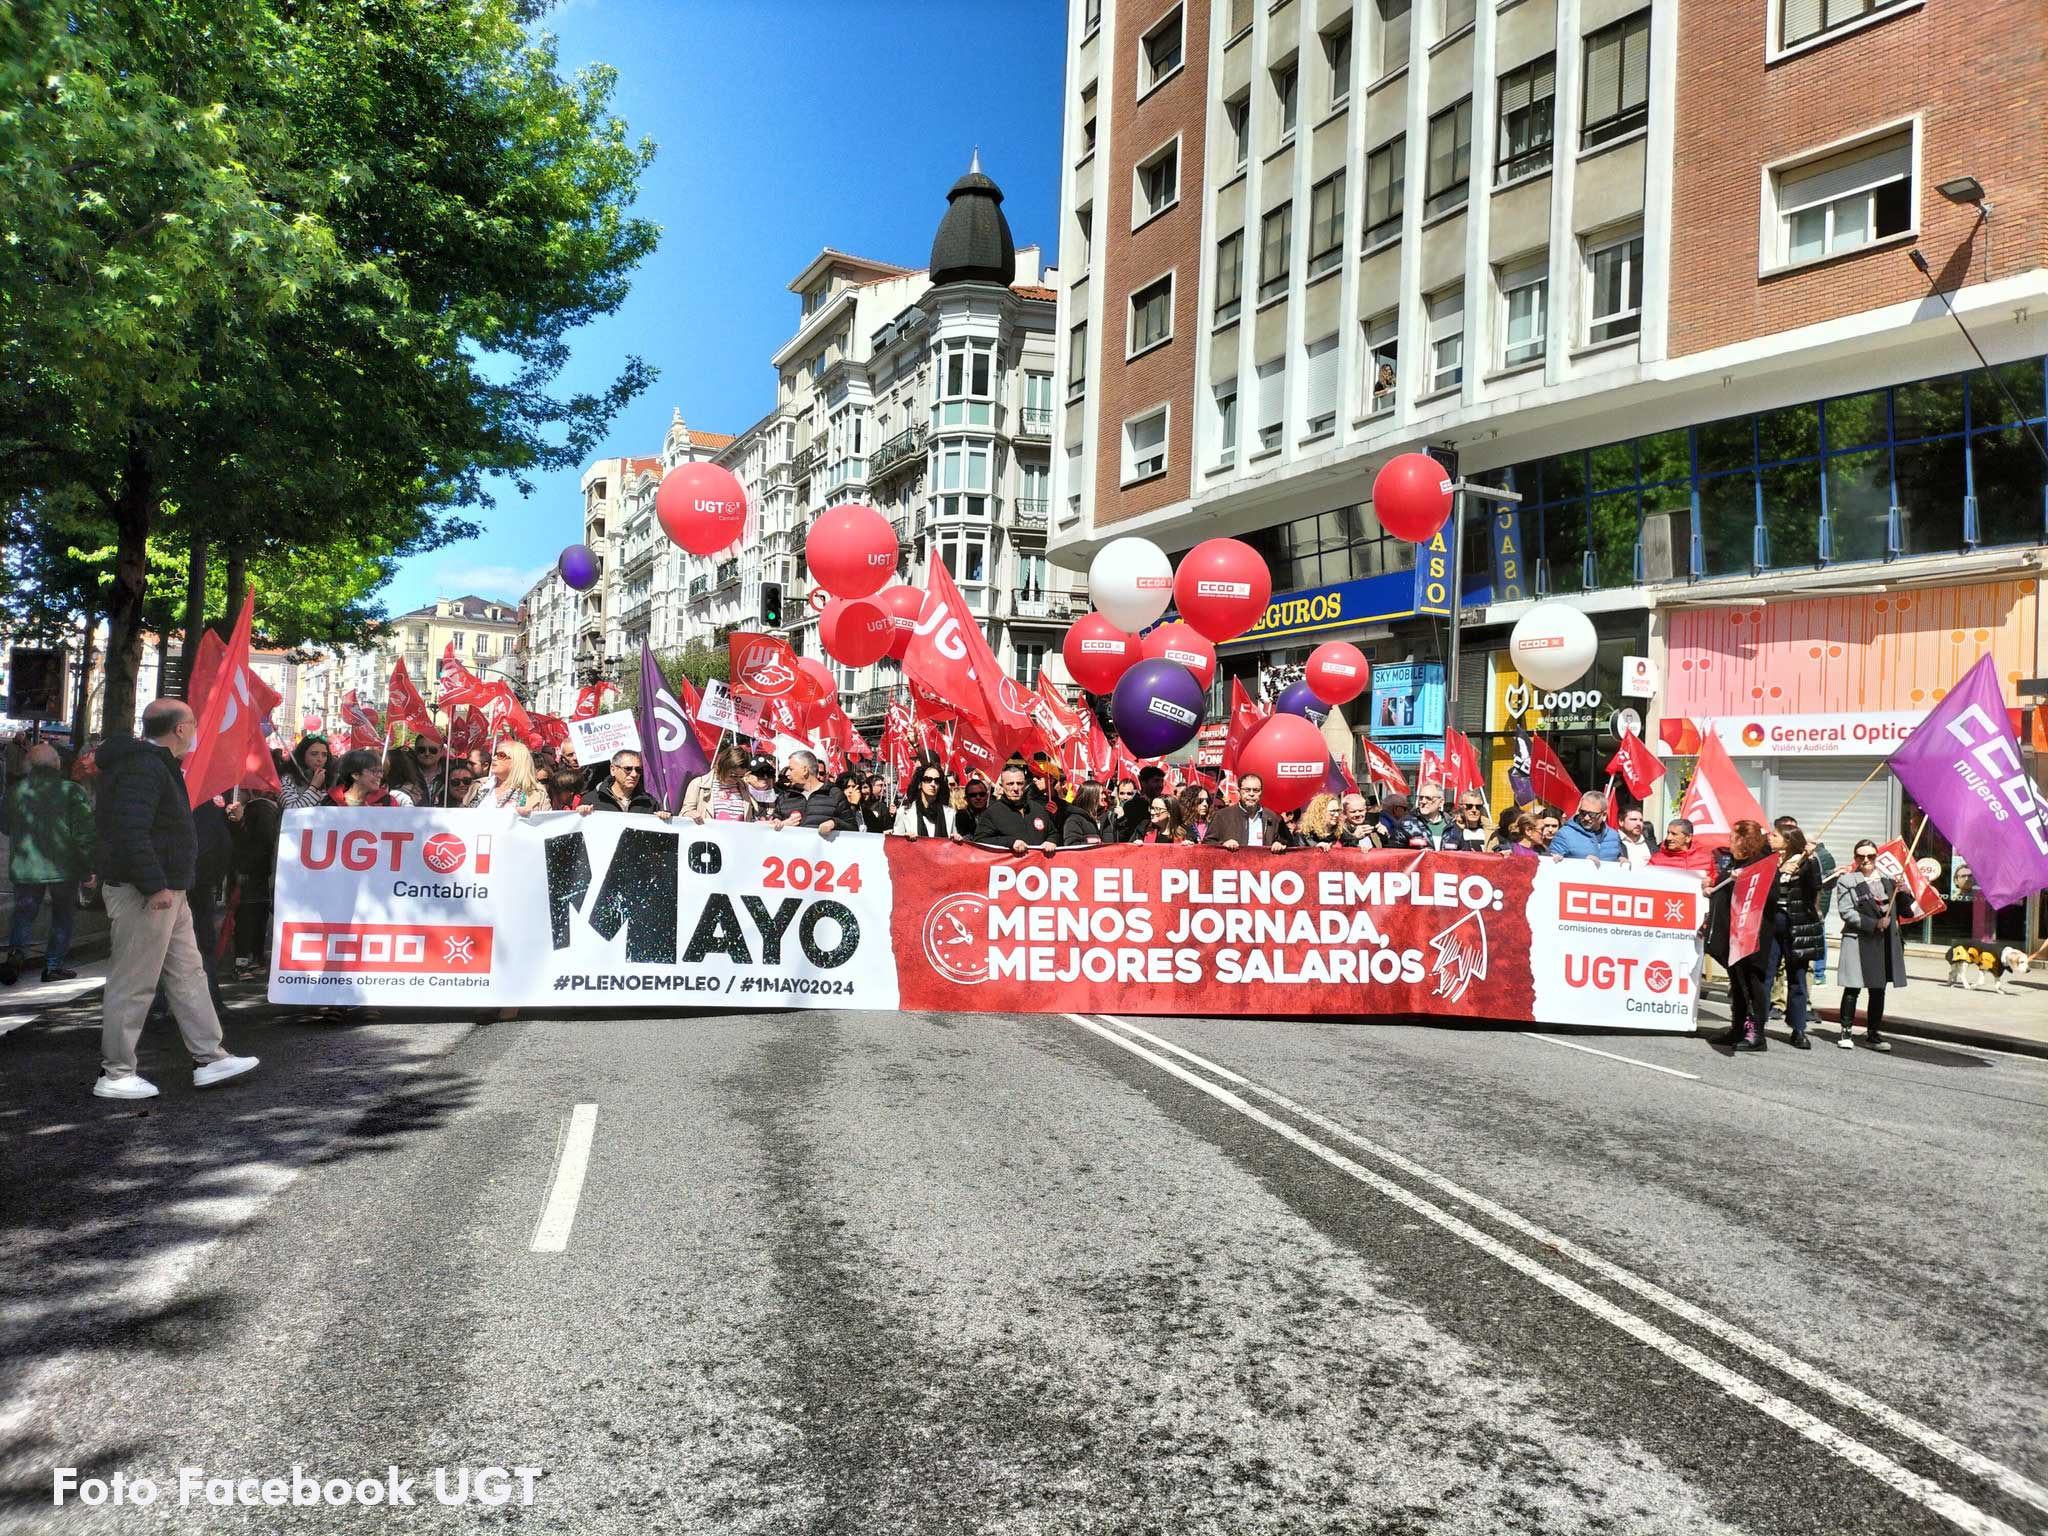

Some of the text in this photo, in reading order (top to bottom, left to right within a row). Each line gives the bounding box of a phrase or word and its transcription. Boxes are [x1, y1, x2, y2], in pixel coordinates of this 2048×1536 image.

[694, 499, 724, 514] UGT
[867, 553, 891, 566] UGT
[1426, 532, 1447, 604] ASO
[1138, 578, 1166, 587] CCOO
[1200, 583, 1234, 592] CCOO
[1248, 593, 1341, 632] EGUROS
[867, 619, 888, 633] UGT
[1084, 641, 1112, 649] CCOO
[1520, 640, 1548, 649] CCOO
[1167, 651, 1196, 662] CCOO
[1375, 667, 1424, 683] SKY MOBILE
[1152, 700, 1185, 718] CCOO
[1533, 690, 1602, 713] Loopo
[1771, 725, 1845, 741] General
[1393, 743, 1424, 755] MOBILE
[1772, 743, 1796, 751] Visión
[1803, 743, 1839, 751] Audición
[1953, 759, 2009, 822] mujeres
[299, 828, 414, 872] UGT
[762, 855, 862, 893] 2024
[393, 881, 488, 899] Cantabria
[988, 865, 1504, 911] POR EL PLENO EMPLEO:
[1566, 889, 1654, 920] CCOO
[1738, 872, 1761, 928] CCOO
[988, 905, 1390, 947] MENOS JORNADA,
[1558, 923, 1696, 941] comisiones obreras de Cantabria
[290, 932, 426, 963] CCOO
[988, 946, 1425, 984] MEJORES SALARIOS
[1564, 953, 1639, 991] UGT
[277, 974, 490, 988] comisiones obreras de Cantabria
[553, 975, 721, 991] #PLENOEMPLEO
[739, 977, 855, 995] #1MAYO2024
[1625, 998, 1689, 1015] Cantabria
